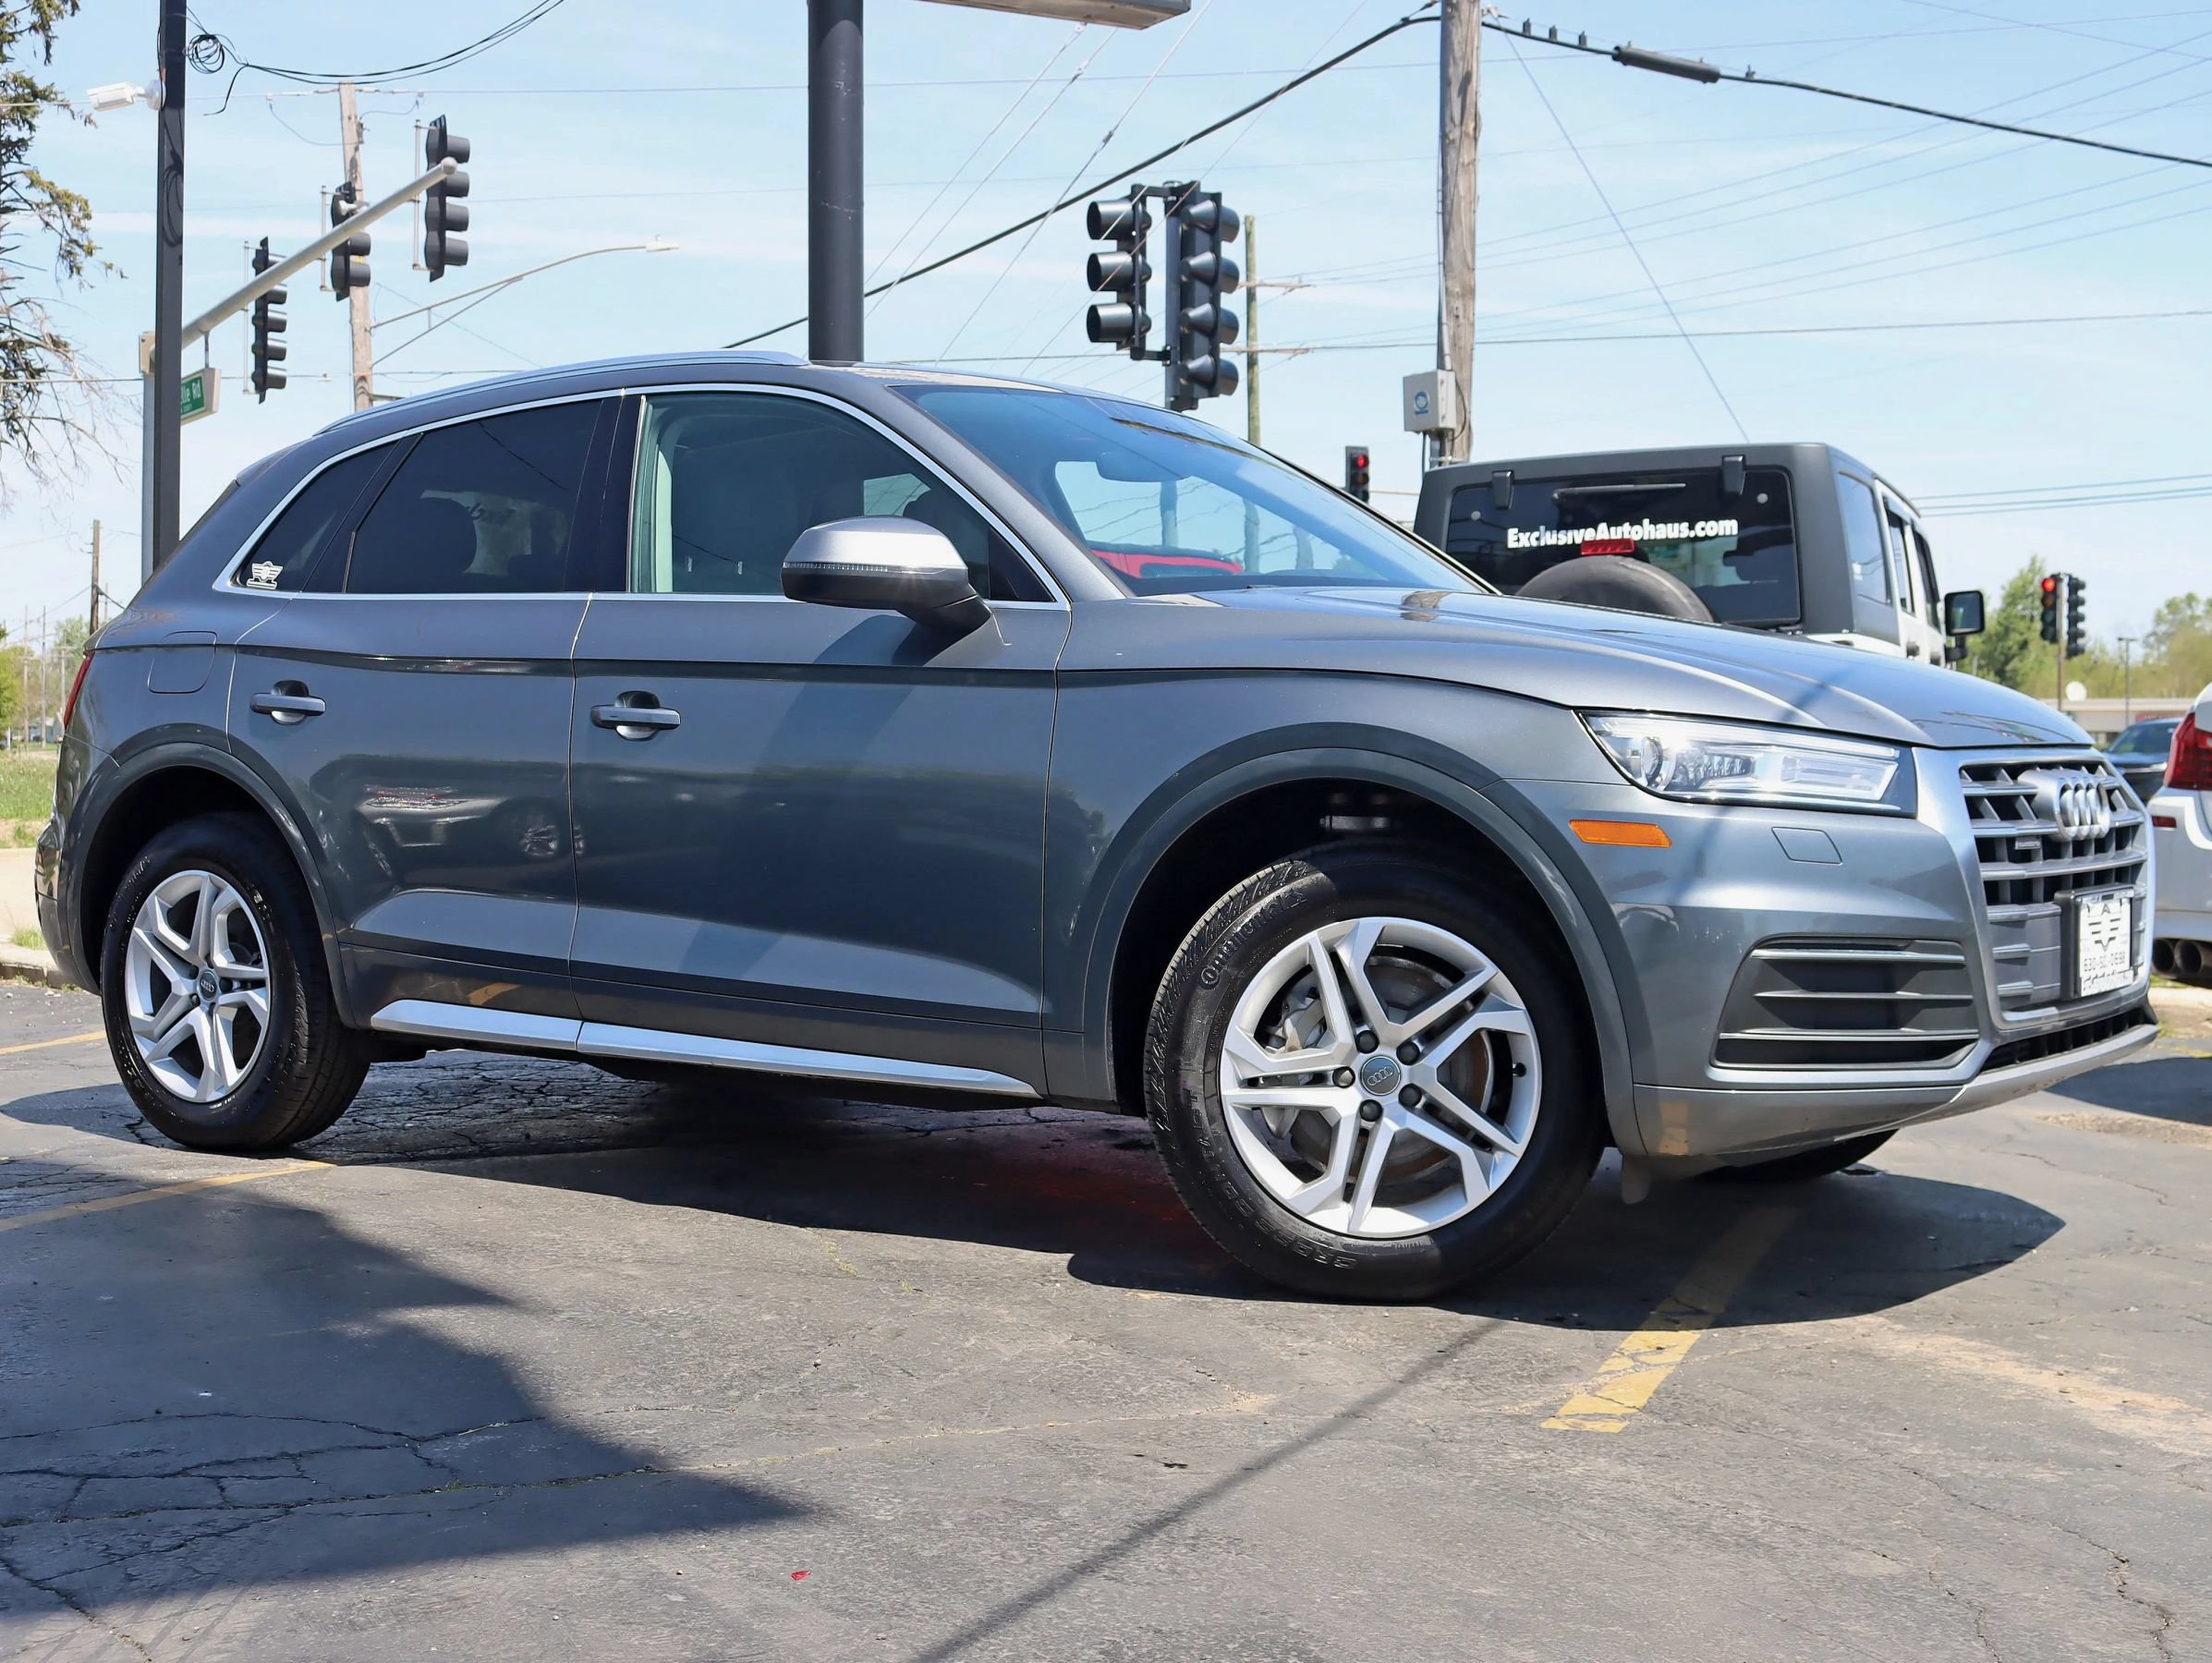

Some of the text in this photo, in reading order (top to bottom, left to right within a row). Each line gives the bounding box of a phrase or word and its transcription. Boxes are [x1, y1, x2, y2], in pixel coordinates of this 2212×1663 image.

[180, 379, 201, 405] lle Rd
[1507, 518, 1738, 548] ExclusiveAutohaus.com
